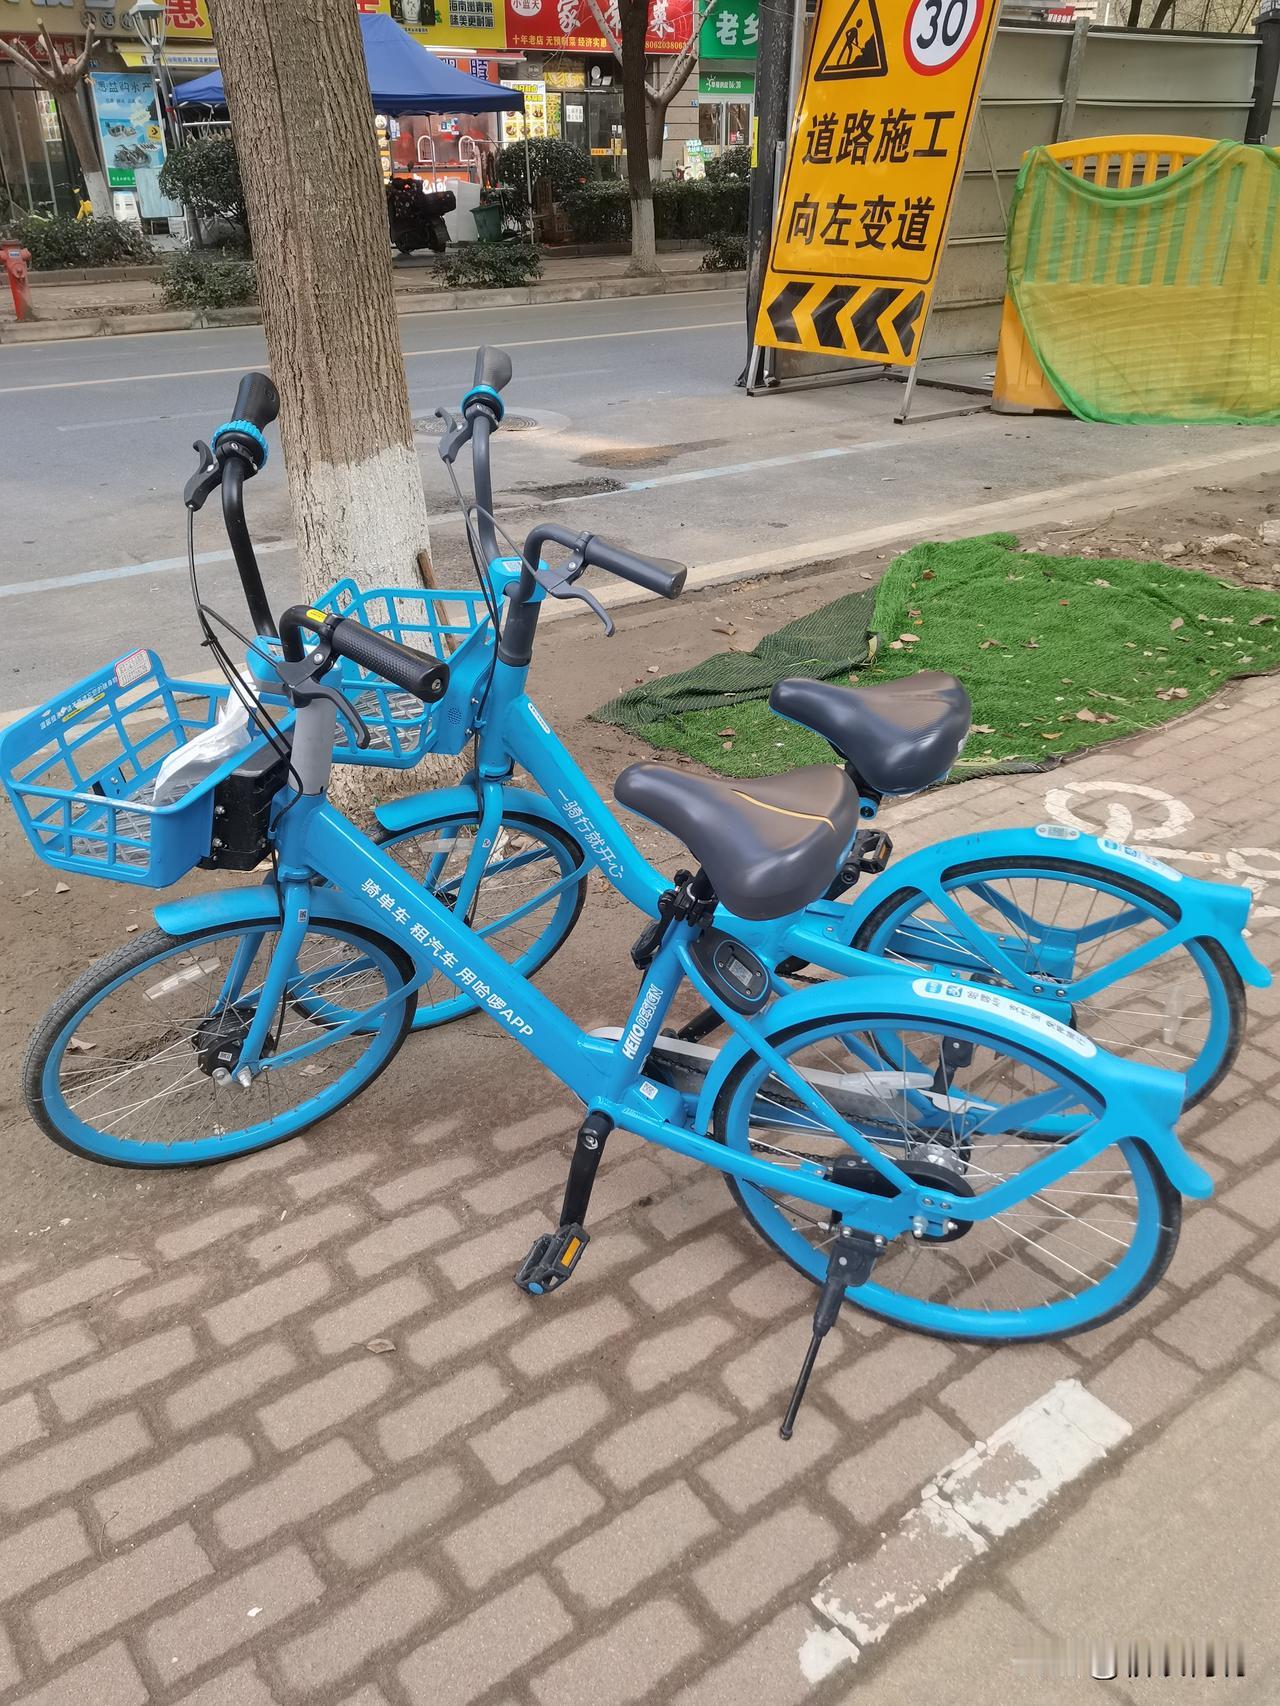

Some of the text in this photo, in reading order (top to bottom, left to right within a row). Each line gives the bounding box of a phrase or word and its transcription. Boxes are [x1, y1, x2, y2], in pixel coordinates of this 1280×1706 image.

[512, 35, 544, 46] 十年老店
[546, 36, 576, 47] 无预制菜
[578, 37, 607, 48] 经济实惠
[916, 0, 969, 49] 30
[802, 108, 955, 165] 道路施工
[786, 193, 936, 251] 向左变道
[558, 789, 623, 879] 一骑行就开心
[361, 878, 534, 1036] 骑单车 租汽车 用哈啰APP
